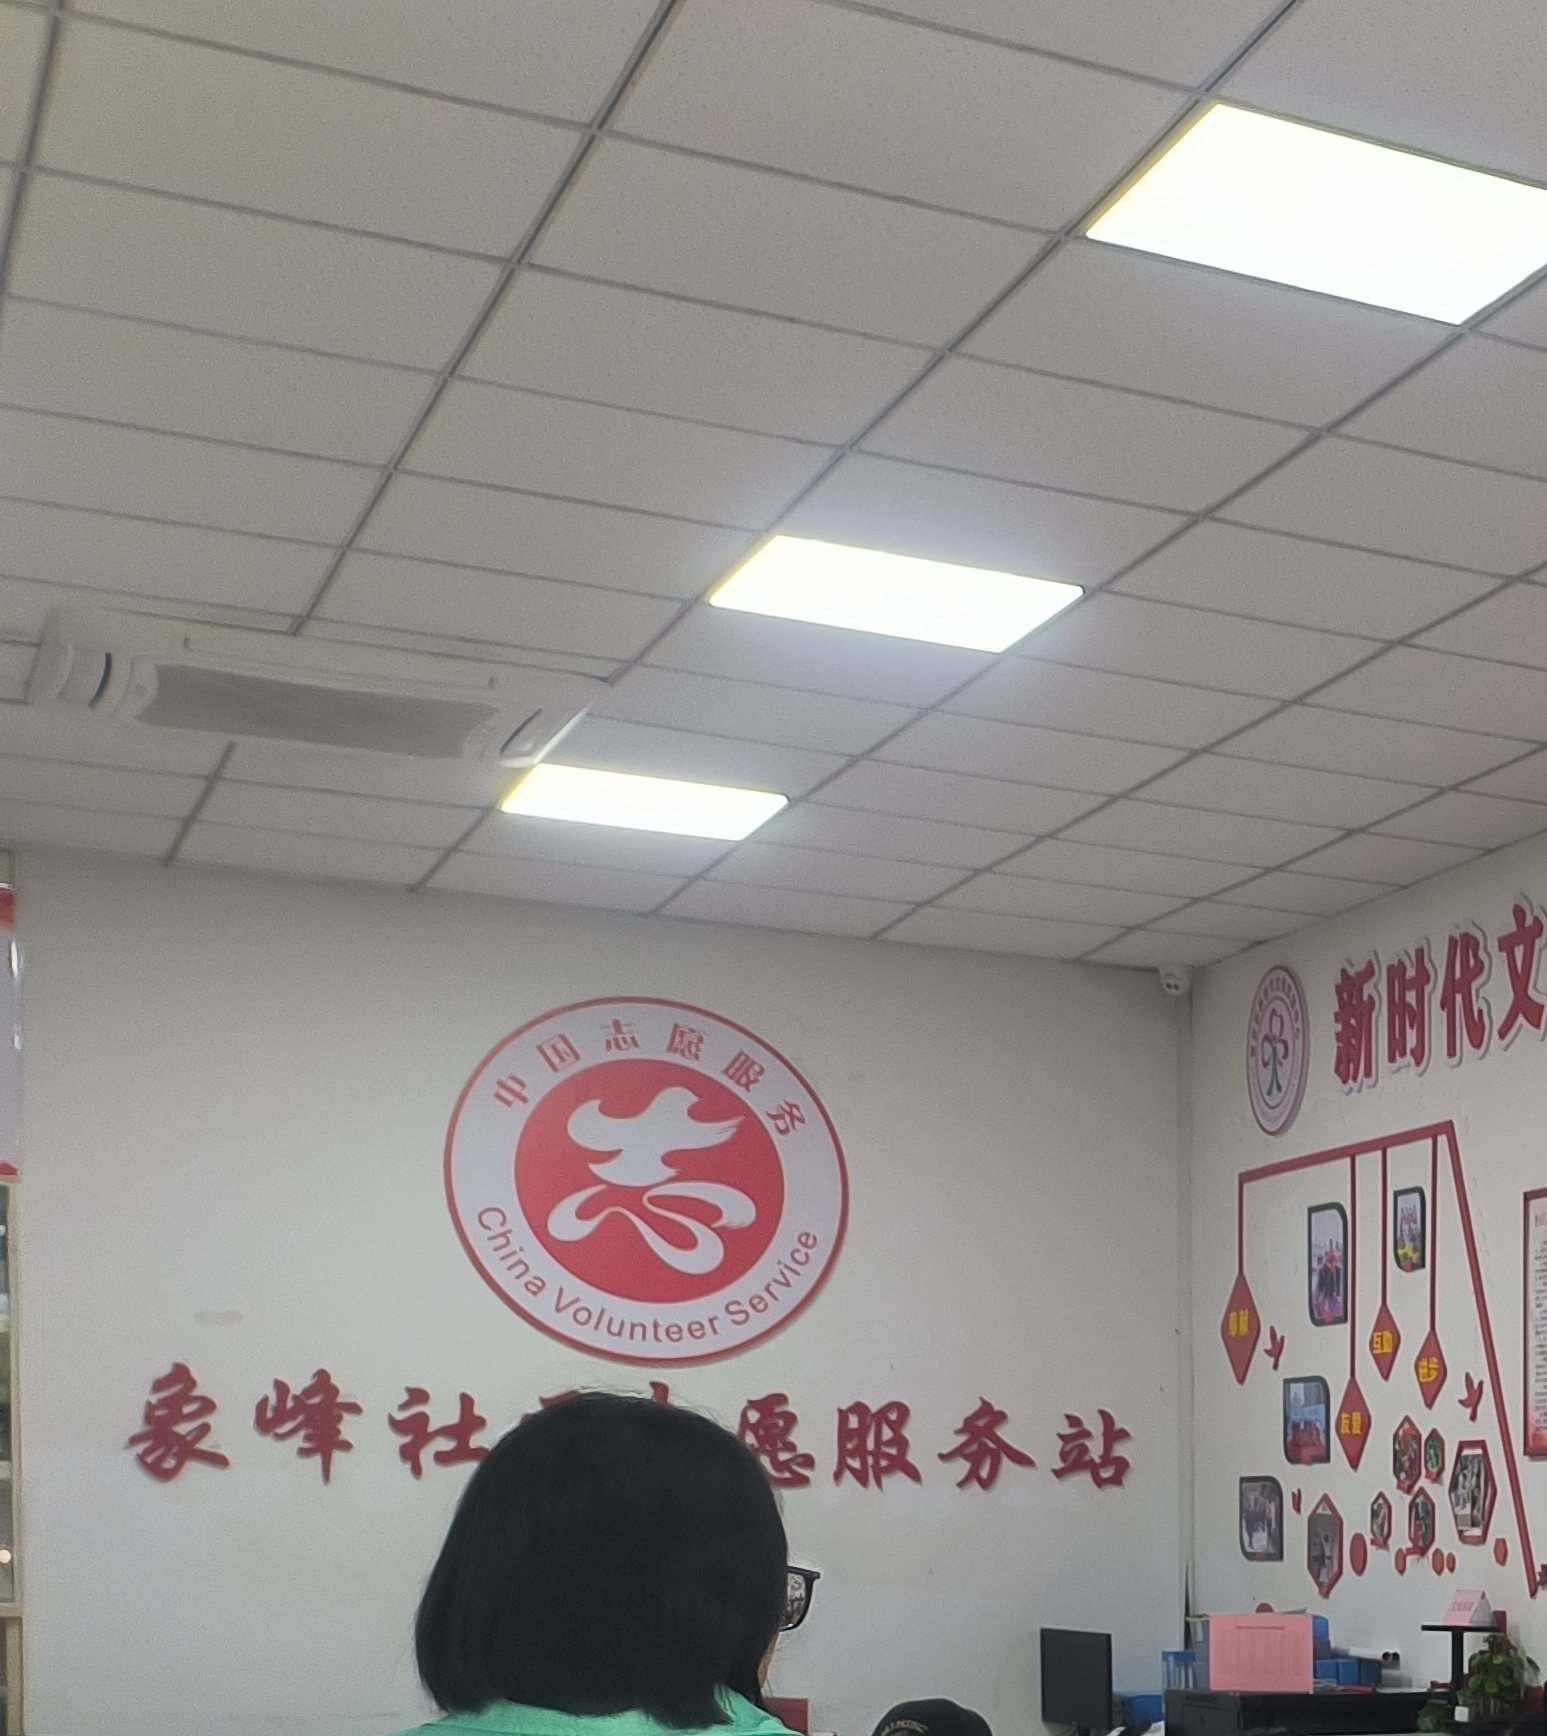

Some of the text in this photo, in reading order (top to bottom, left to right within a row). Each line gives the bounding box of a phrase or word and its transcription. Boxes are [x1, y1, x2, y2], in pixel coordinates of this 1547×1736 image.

[493, 1018, 807, 1137] 中国志愿服务
[478, 1206, 818, 1343] China Volunteer Service
[126, 1360, 1138, 1491] 象峰社愿服务站
